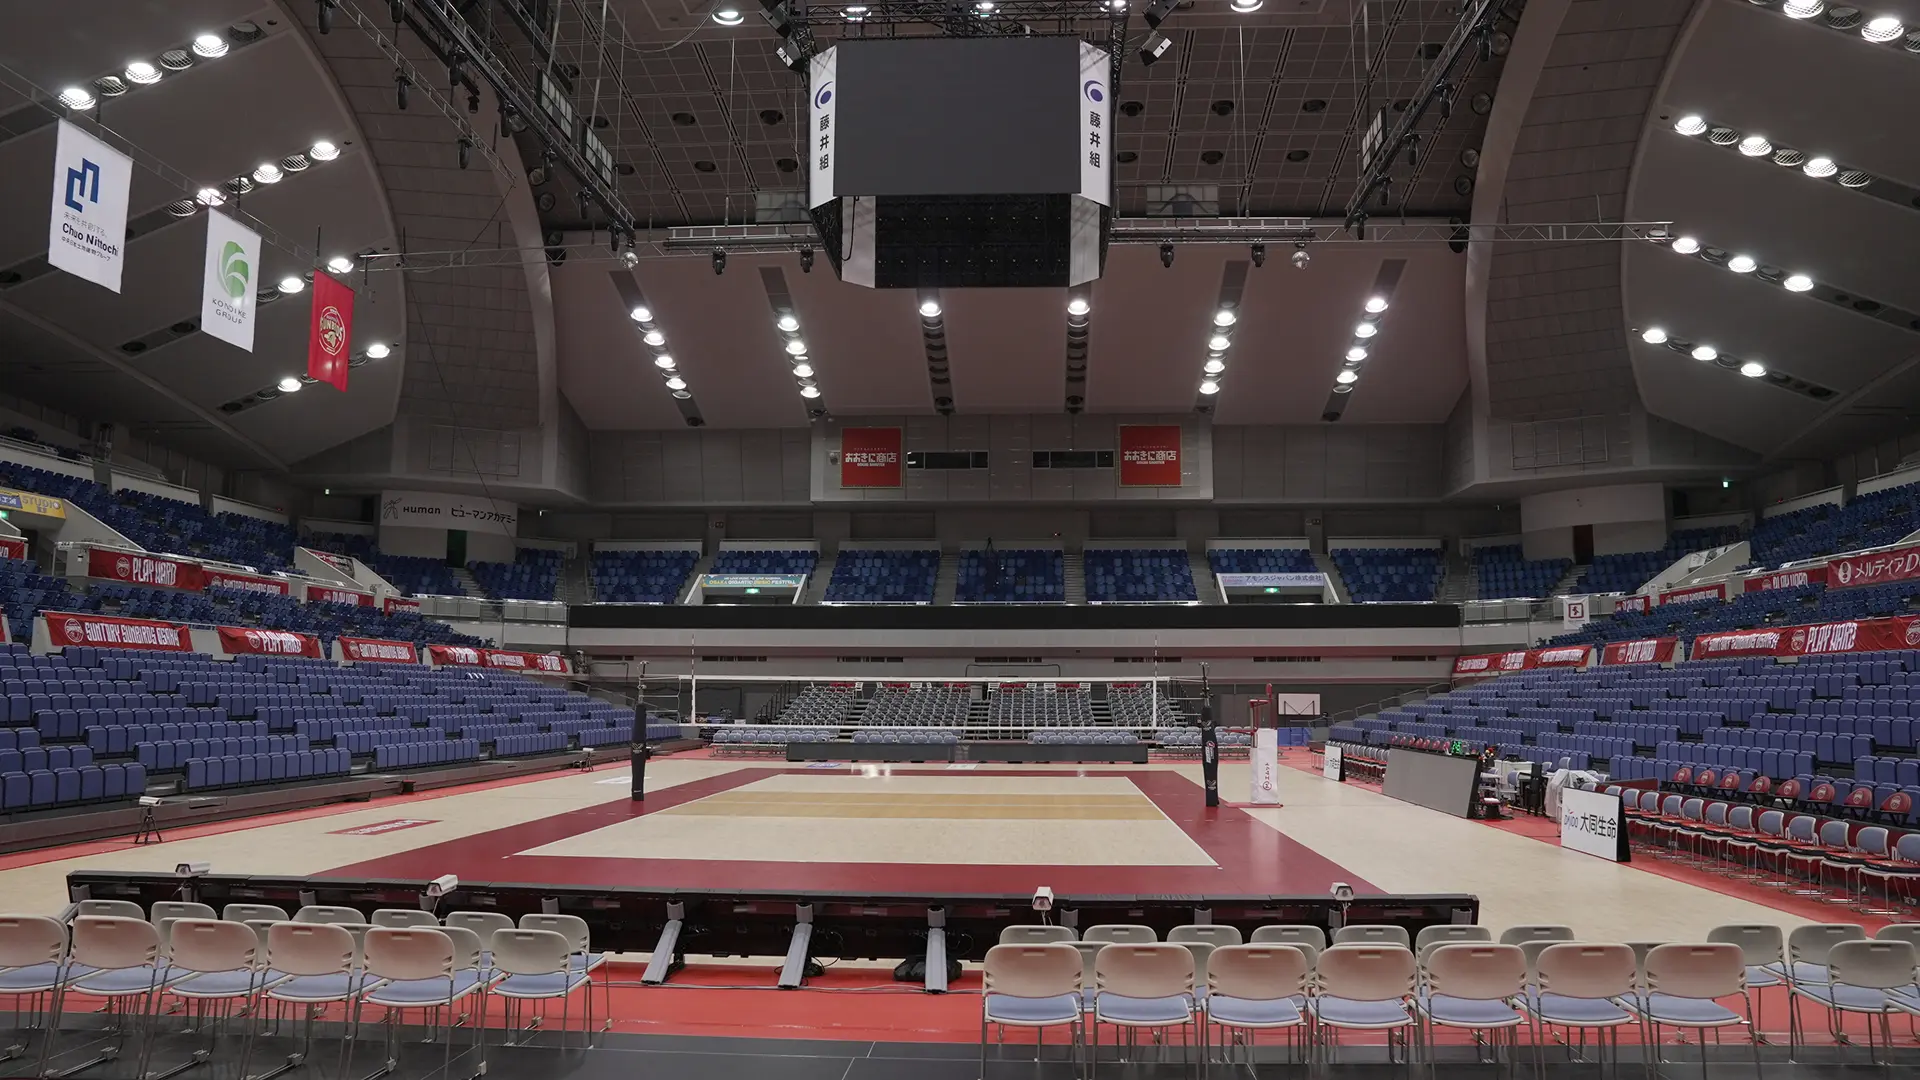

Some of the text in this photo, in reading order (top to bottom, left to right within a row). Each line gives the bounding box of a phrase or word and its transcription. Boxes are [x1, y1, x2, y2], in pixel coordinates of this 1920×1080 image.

[820, 114, 830, 170] 藤井組
[1089, 111, 1100, 168] 藤井組
[62, 222, 119, 256] Chuo Nittochi
[215, 308, 242, 324] GROUP
[845, 452, 897, 462] おおきに商店
[1124, 450, 1176, 461] おおきに商店
[22, 495, 61, 510] STUDIO
[403, 506, 440, 514] Human
[451, 505, 516, 524] ヒューマンアカデミー
[132, 557, 177, 586] PLAY HARD
[84, 622, 121, 643] SUNTORY
[120, 624, 157, 645] SUNBIRDS
[1805, 625, 1832, 652] PLAY
[1624, 642, 1642, 662] PLAY
[1580, 812, 1616, 840] 大同生命
